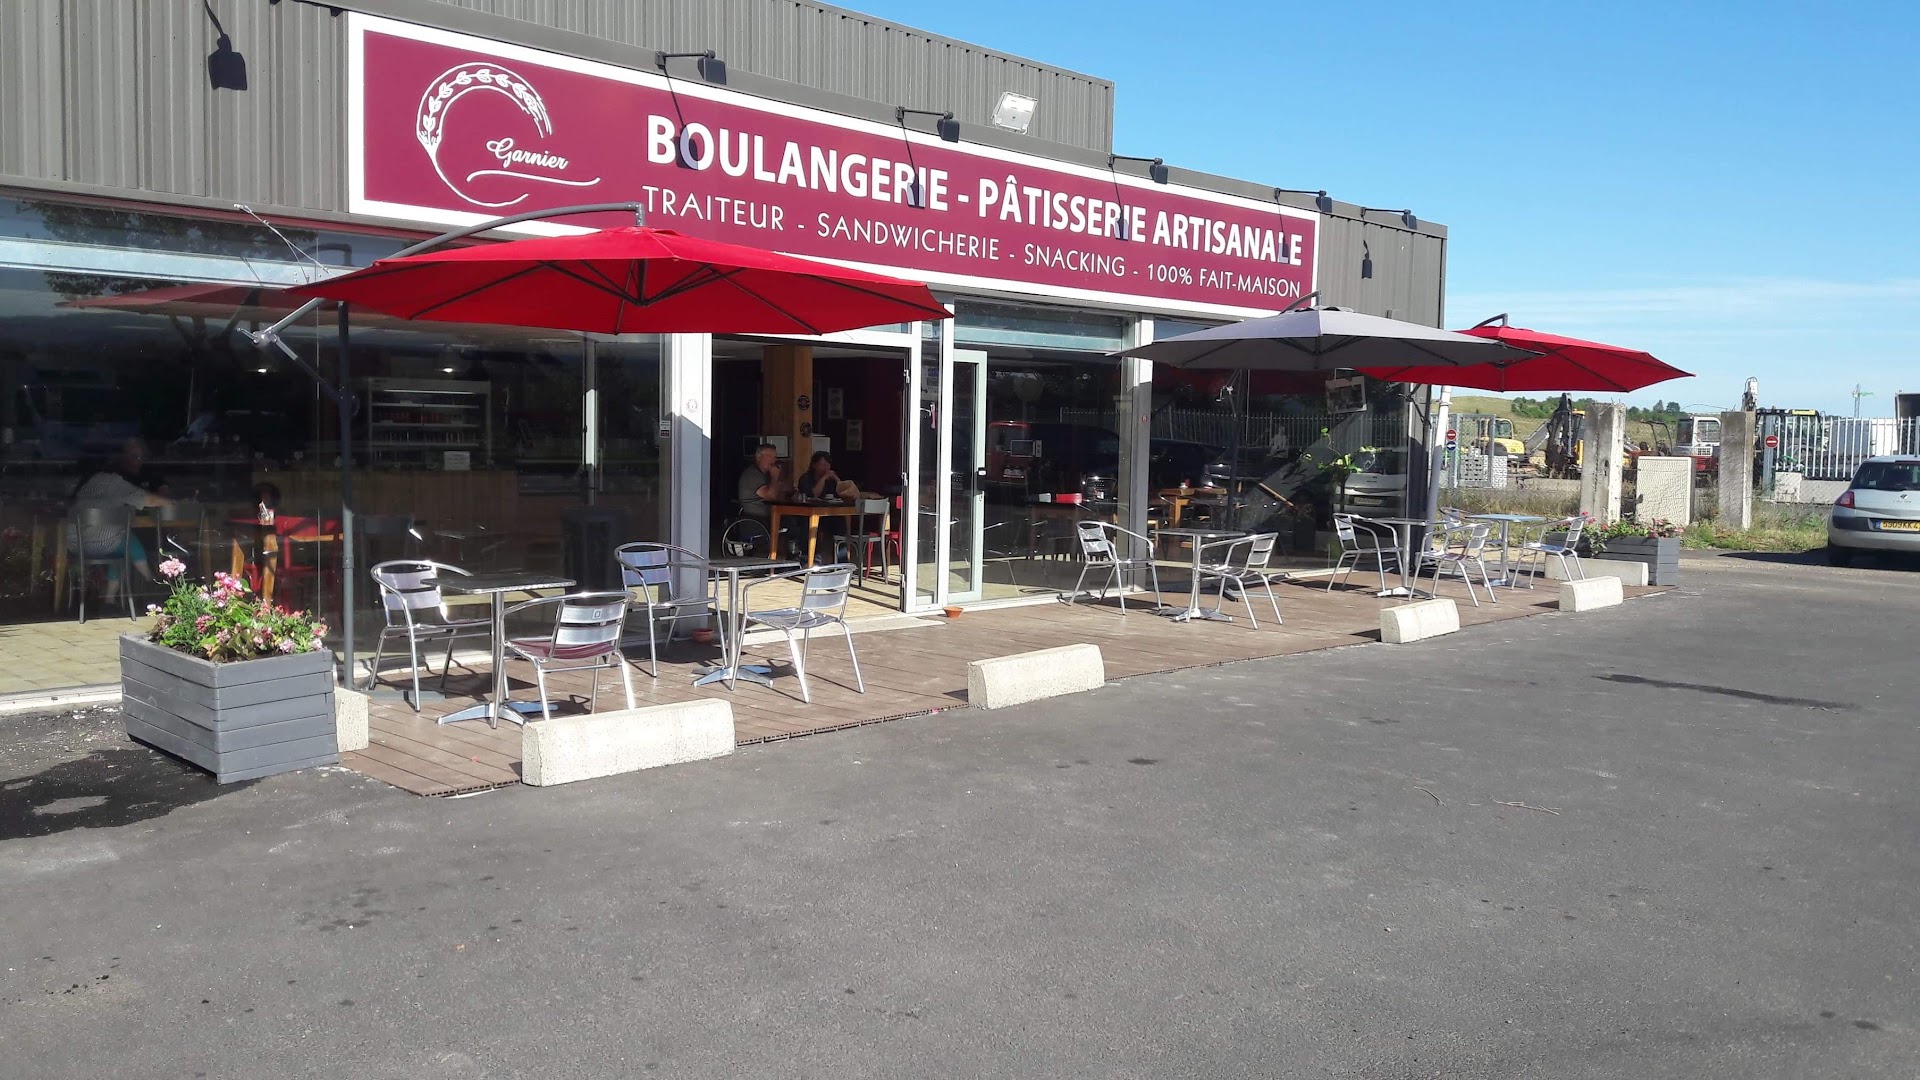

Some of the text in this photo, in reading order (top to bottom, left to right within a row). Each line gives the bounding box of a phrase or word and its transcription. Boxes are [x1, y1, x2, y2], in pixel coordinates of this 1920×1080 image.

[486, 137, 568, 169] Garnier
[647, 114, 948, 211] BOULANGERIE
[978, 174, 1147, 243] PÂTISSERIE
[1152, 210, 1303, 266] ARTISANALE
[642, 185, 784, 231] TRAITEUR
[817, 212, 1000, 260] SANDWICHERIE
[1024, 243, 1125, 277] SNACKING
[1147, 263, 1193, 285] 100%
[1199, 268, 1300, 299] FAIT-MAISON
